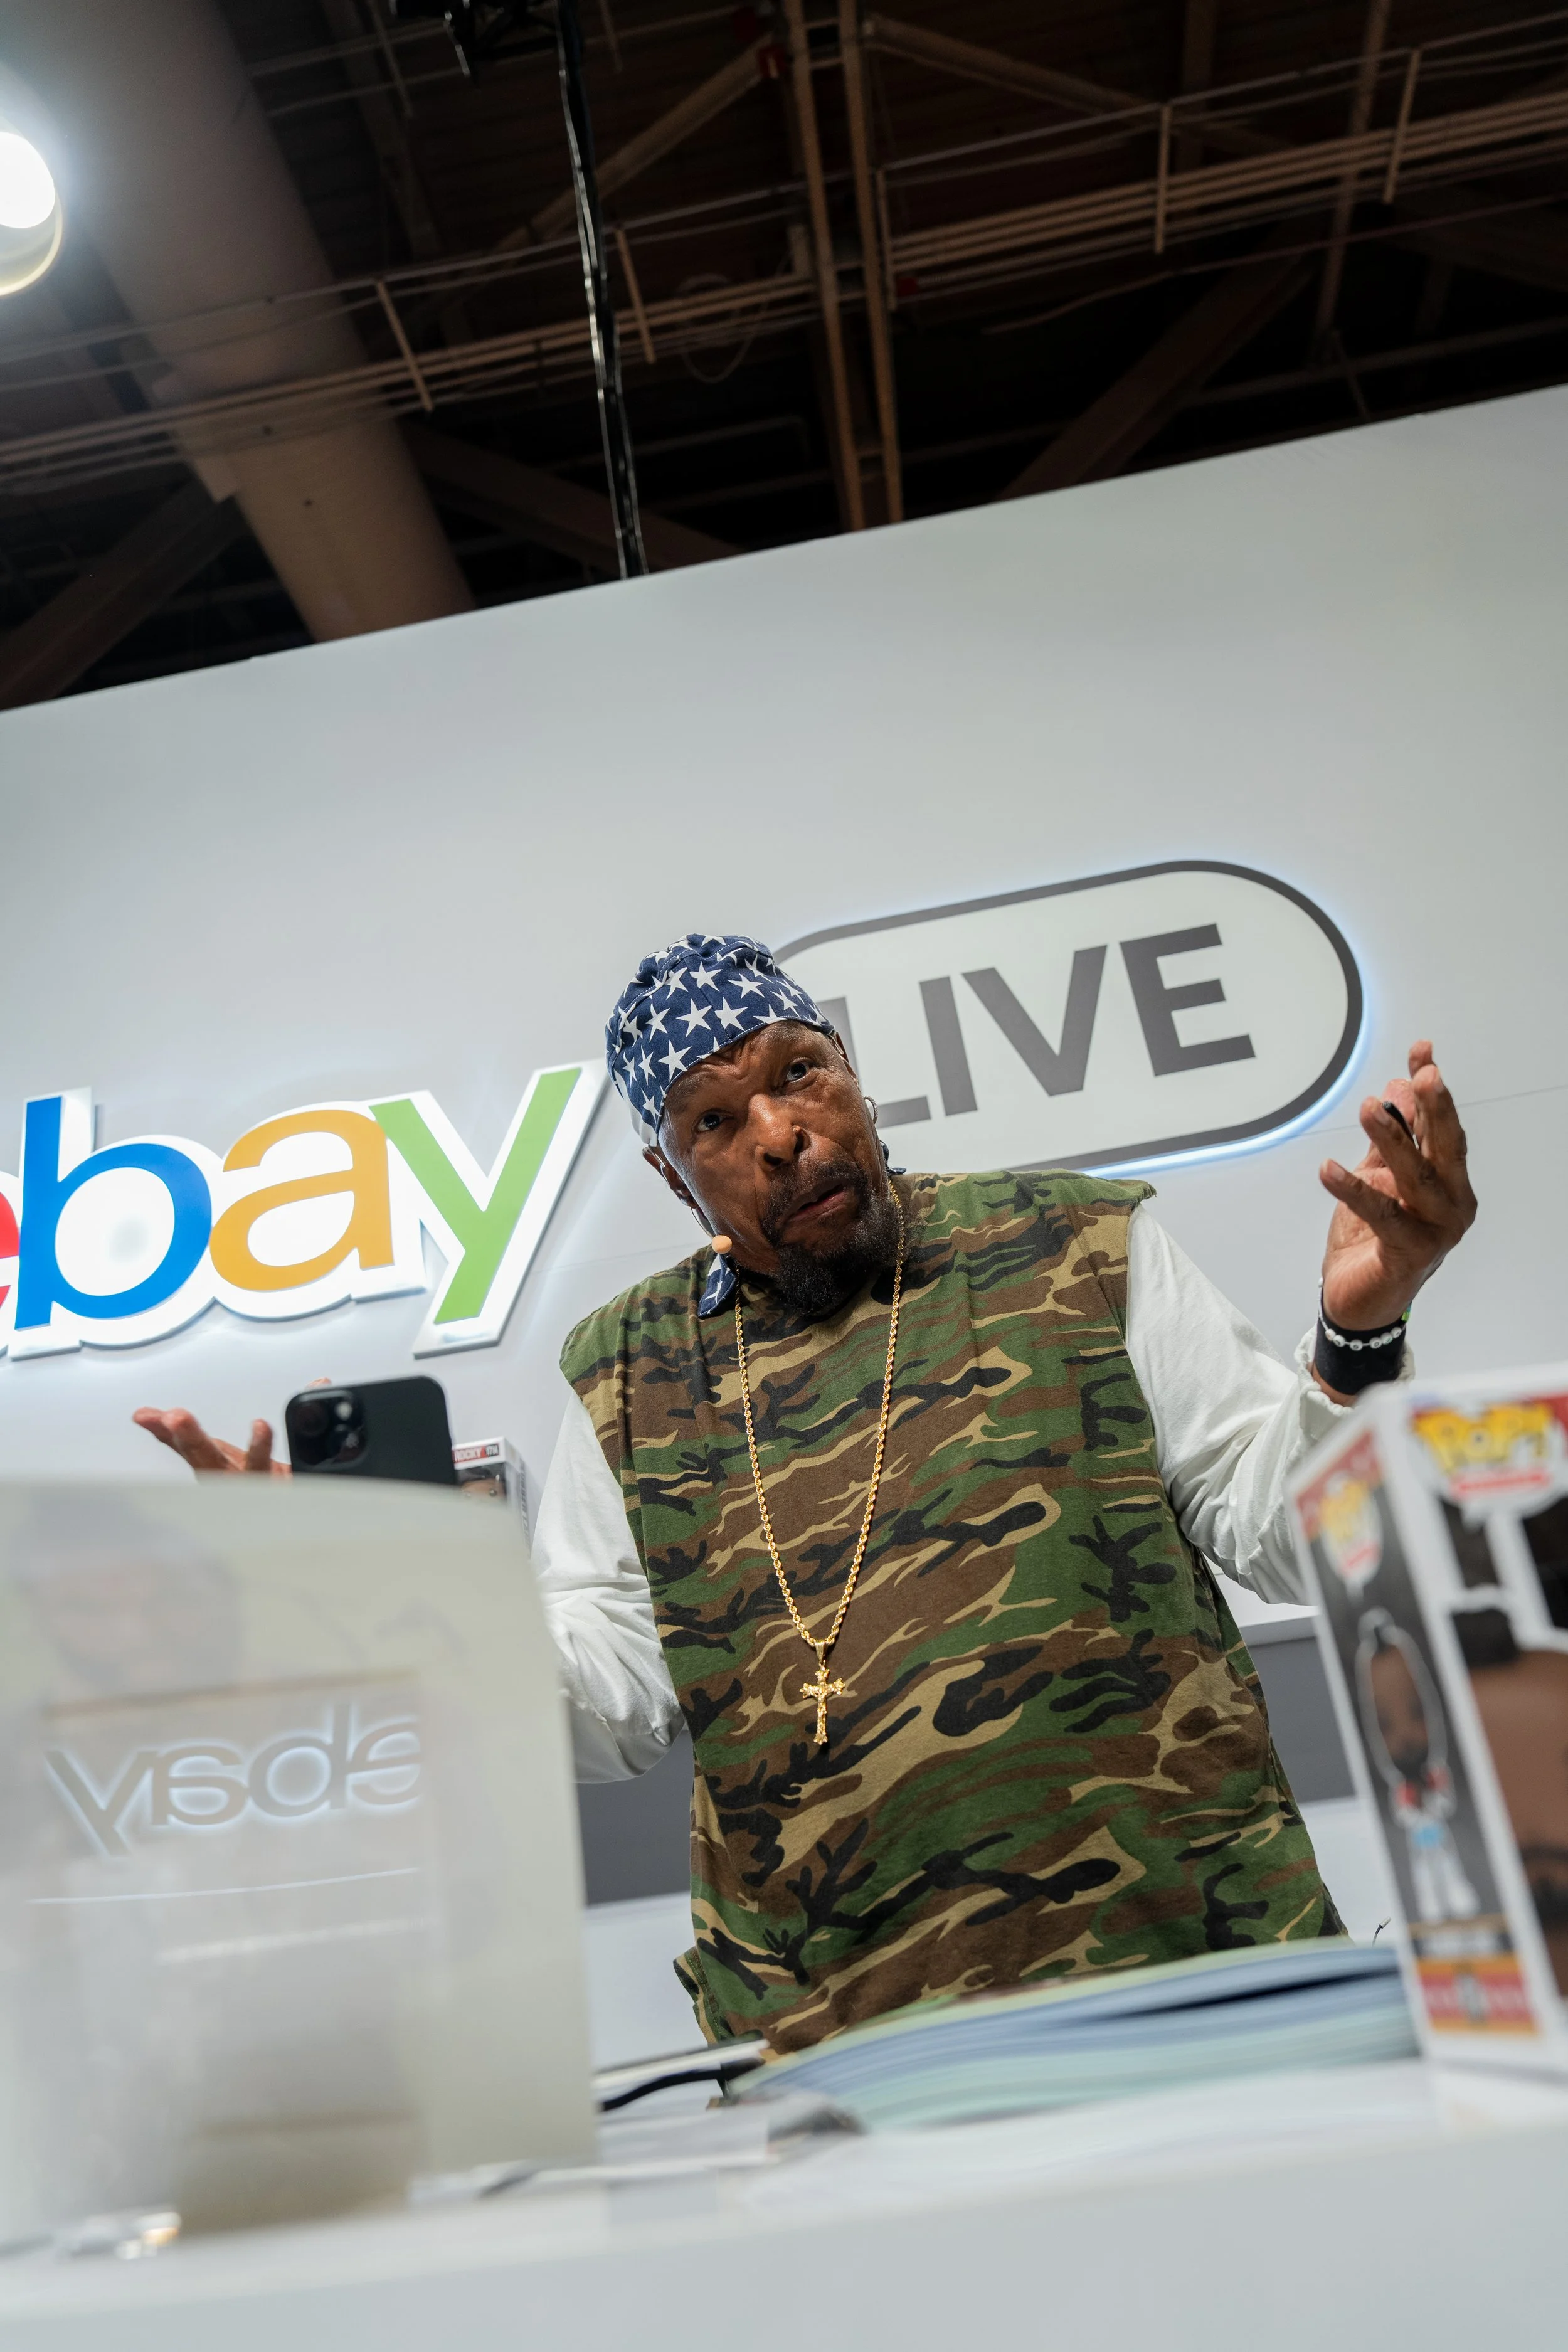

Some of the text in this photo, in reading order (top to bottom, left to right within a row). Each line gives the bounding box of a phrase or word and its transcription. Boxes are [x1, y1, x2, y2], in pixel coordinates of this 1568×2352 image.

[817, 923, 1255, 1129] LIVE
[0, 1067, 582, 1331] bay
[454, 1446, 482, 1463] ROCKY
